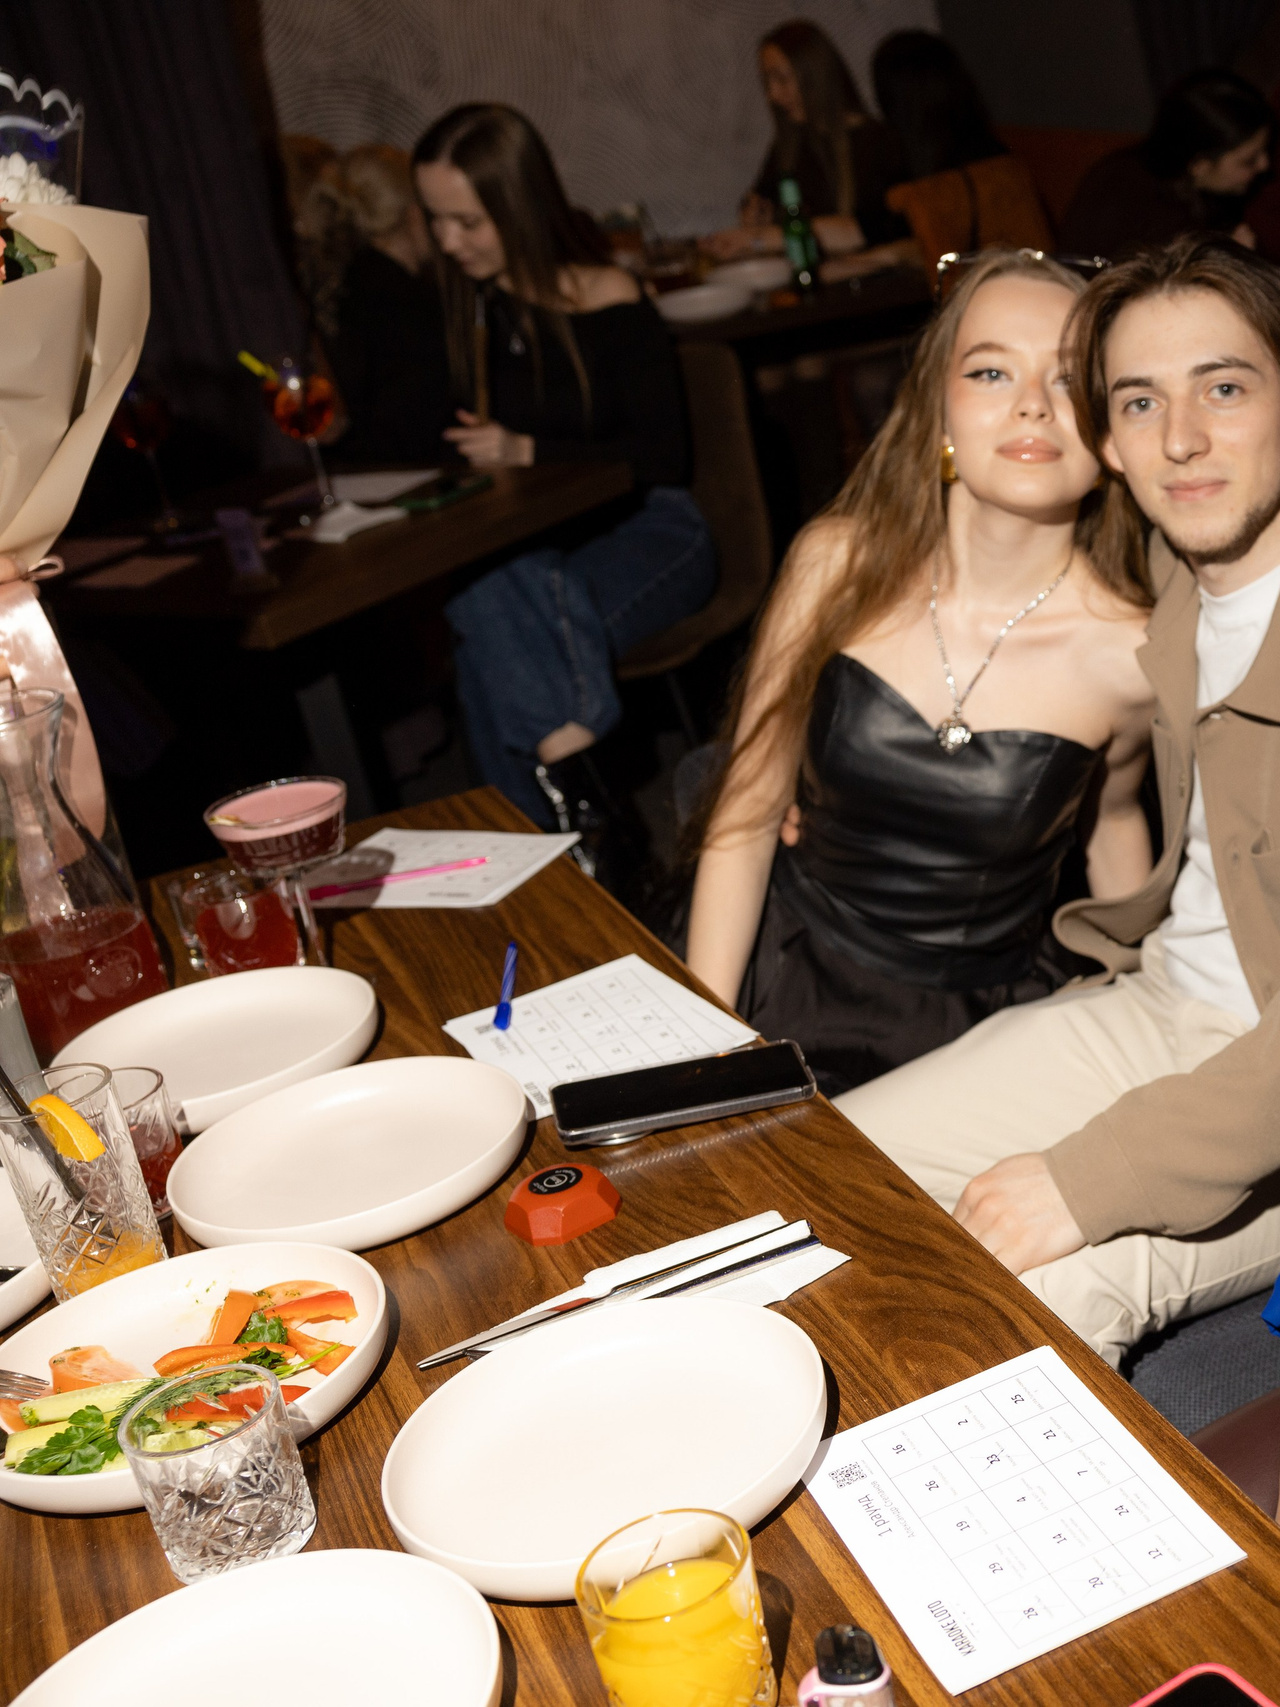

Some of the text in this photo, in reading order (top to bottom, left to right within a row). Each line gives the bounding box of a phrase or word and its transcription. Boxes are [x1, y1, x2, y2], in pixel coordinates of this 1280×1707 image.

[1010, 1393, 1025, 1404] 25
[957, 1418, 968, 1426] 2
[1042, 1428, 1056, 1440] 21
[891, 1443, 906, 1454] 16
[985, 1453, 1000, 1466] 23
[924, 1479, 939, 1491] 26
[857, 1493, 890, 1527] раунд
[1113, 1504, 1129, 1516] 24
[877, 1527, 892, 1536] 1
[955, 1520, 970, 1531] 19
[1051, 1532, 1067, 1544] 14
[1147, 1547, 1163, 1559] 12
[988, 1561, 1003, 1574] 29
[1087, 1576, 1103, 1588] 20
[926, 1599, 951, 1622] LOTO
[1022, 1606, 1038, 1619] 28
[940, 1618, 976, 1656] KARAOKE
